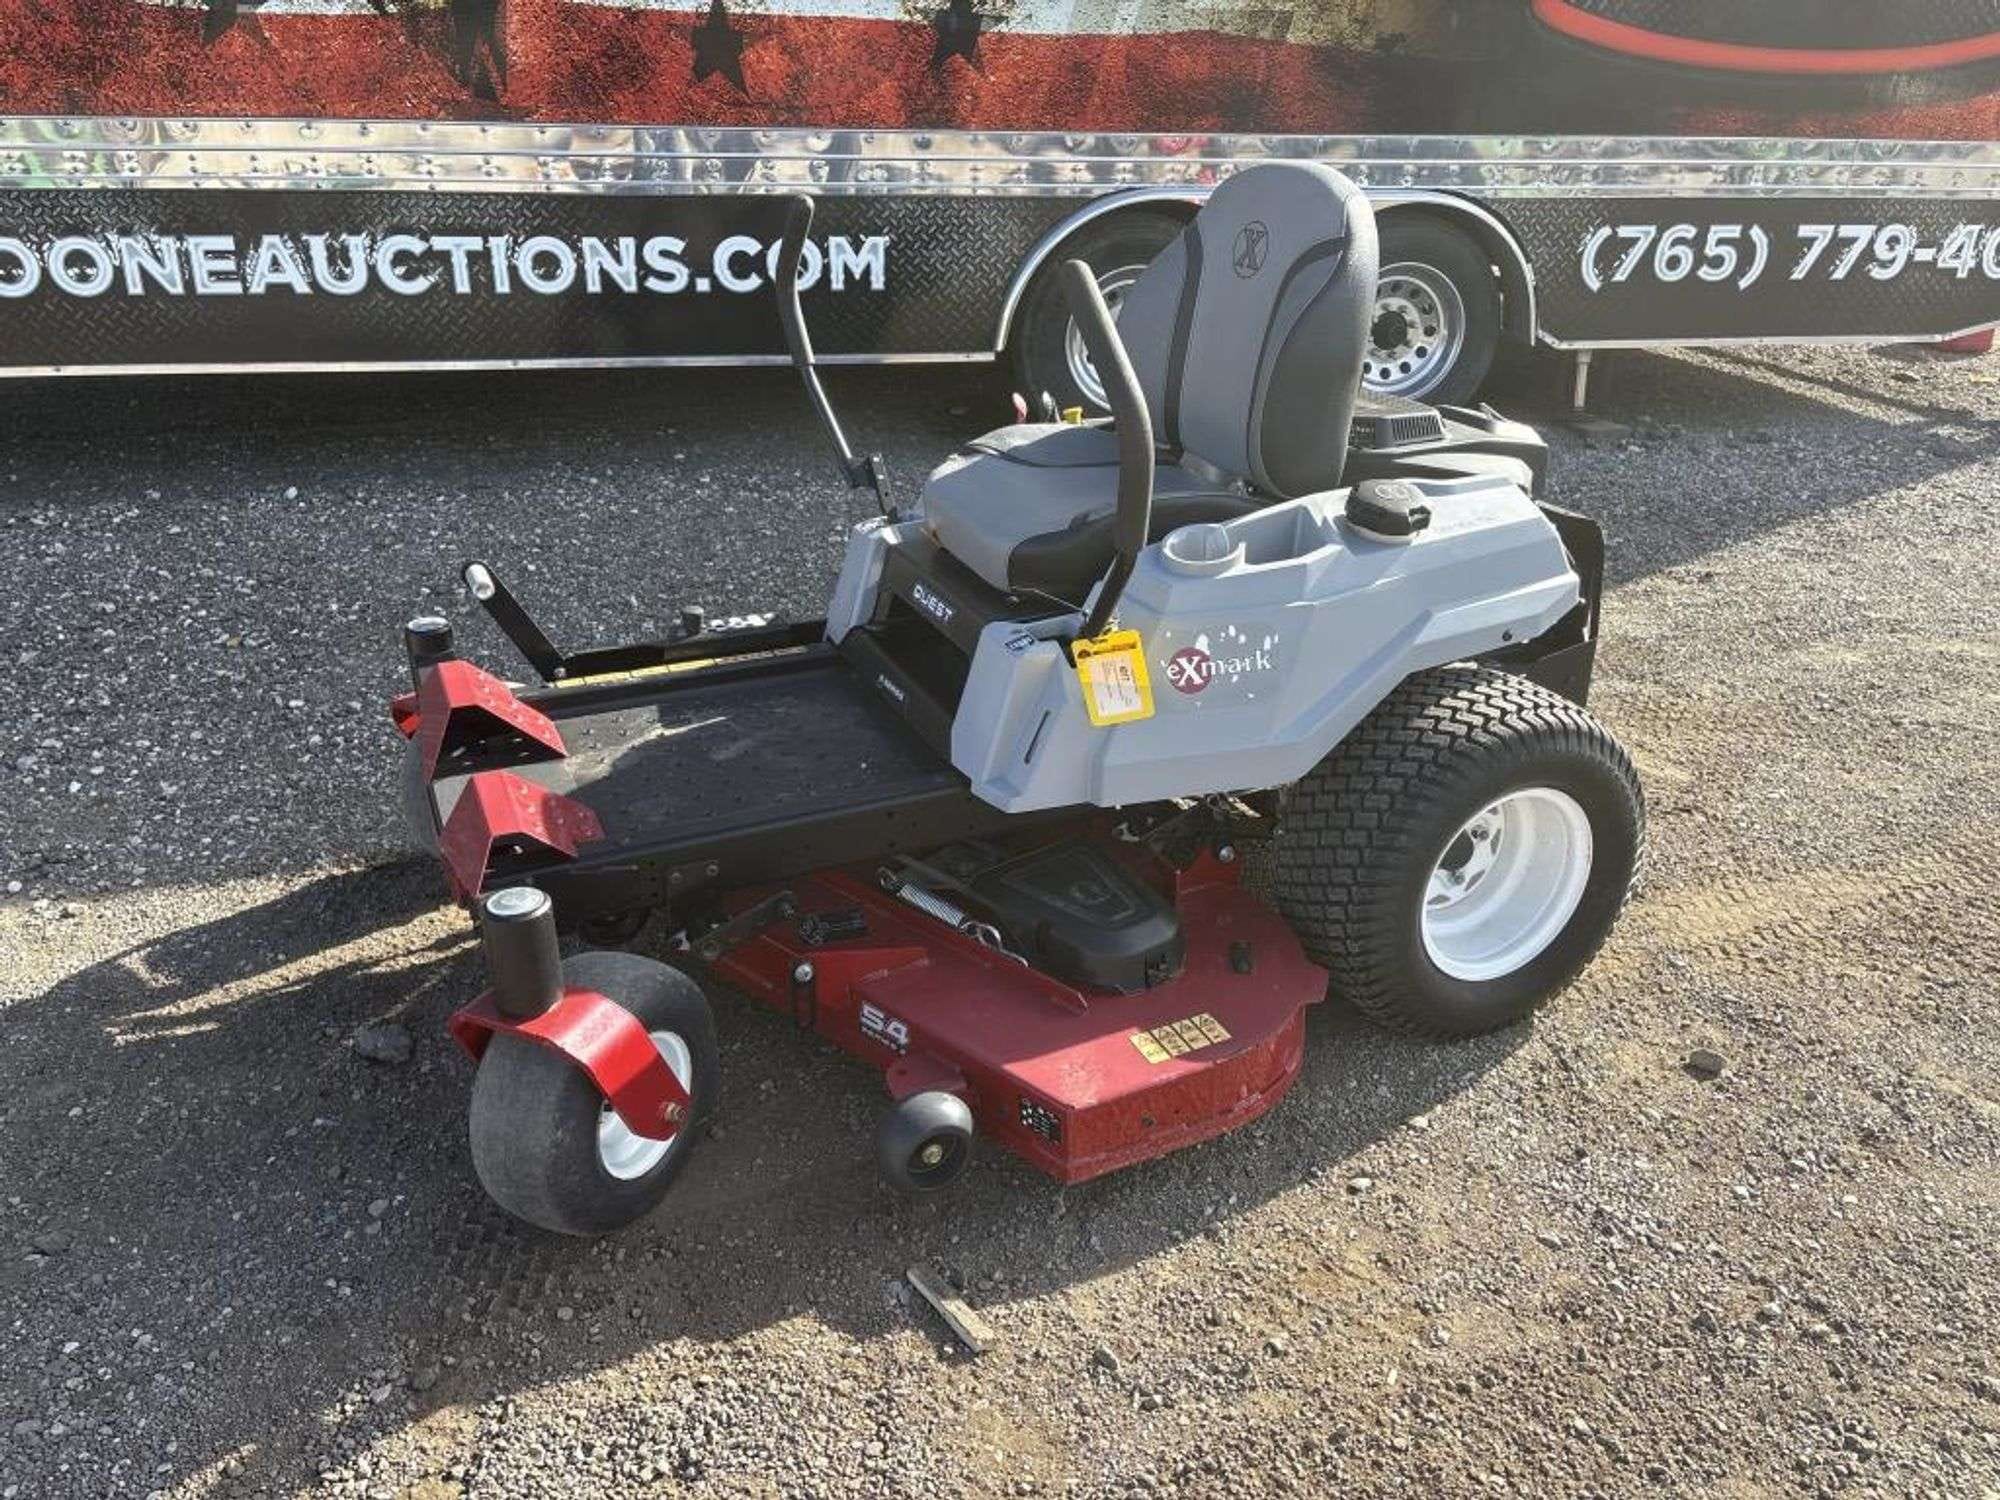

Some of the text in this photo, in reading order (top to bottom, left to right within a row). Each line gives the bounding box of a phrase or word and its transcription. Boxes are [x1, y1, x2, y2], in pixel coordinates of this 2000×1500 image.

[1580, 224, 1769, 293] (765)
[912, 583, 953, 624] QUEST
[860, 1003, 908, 1045] 54
